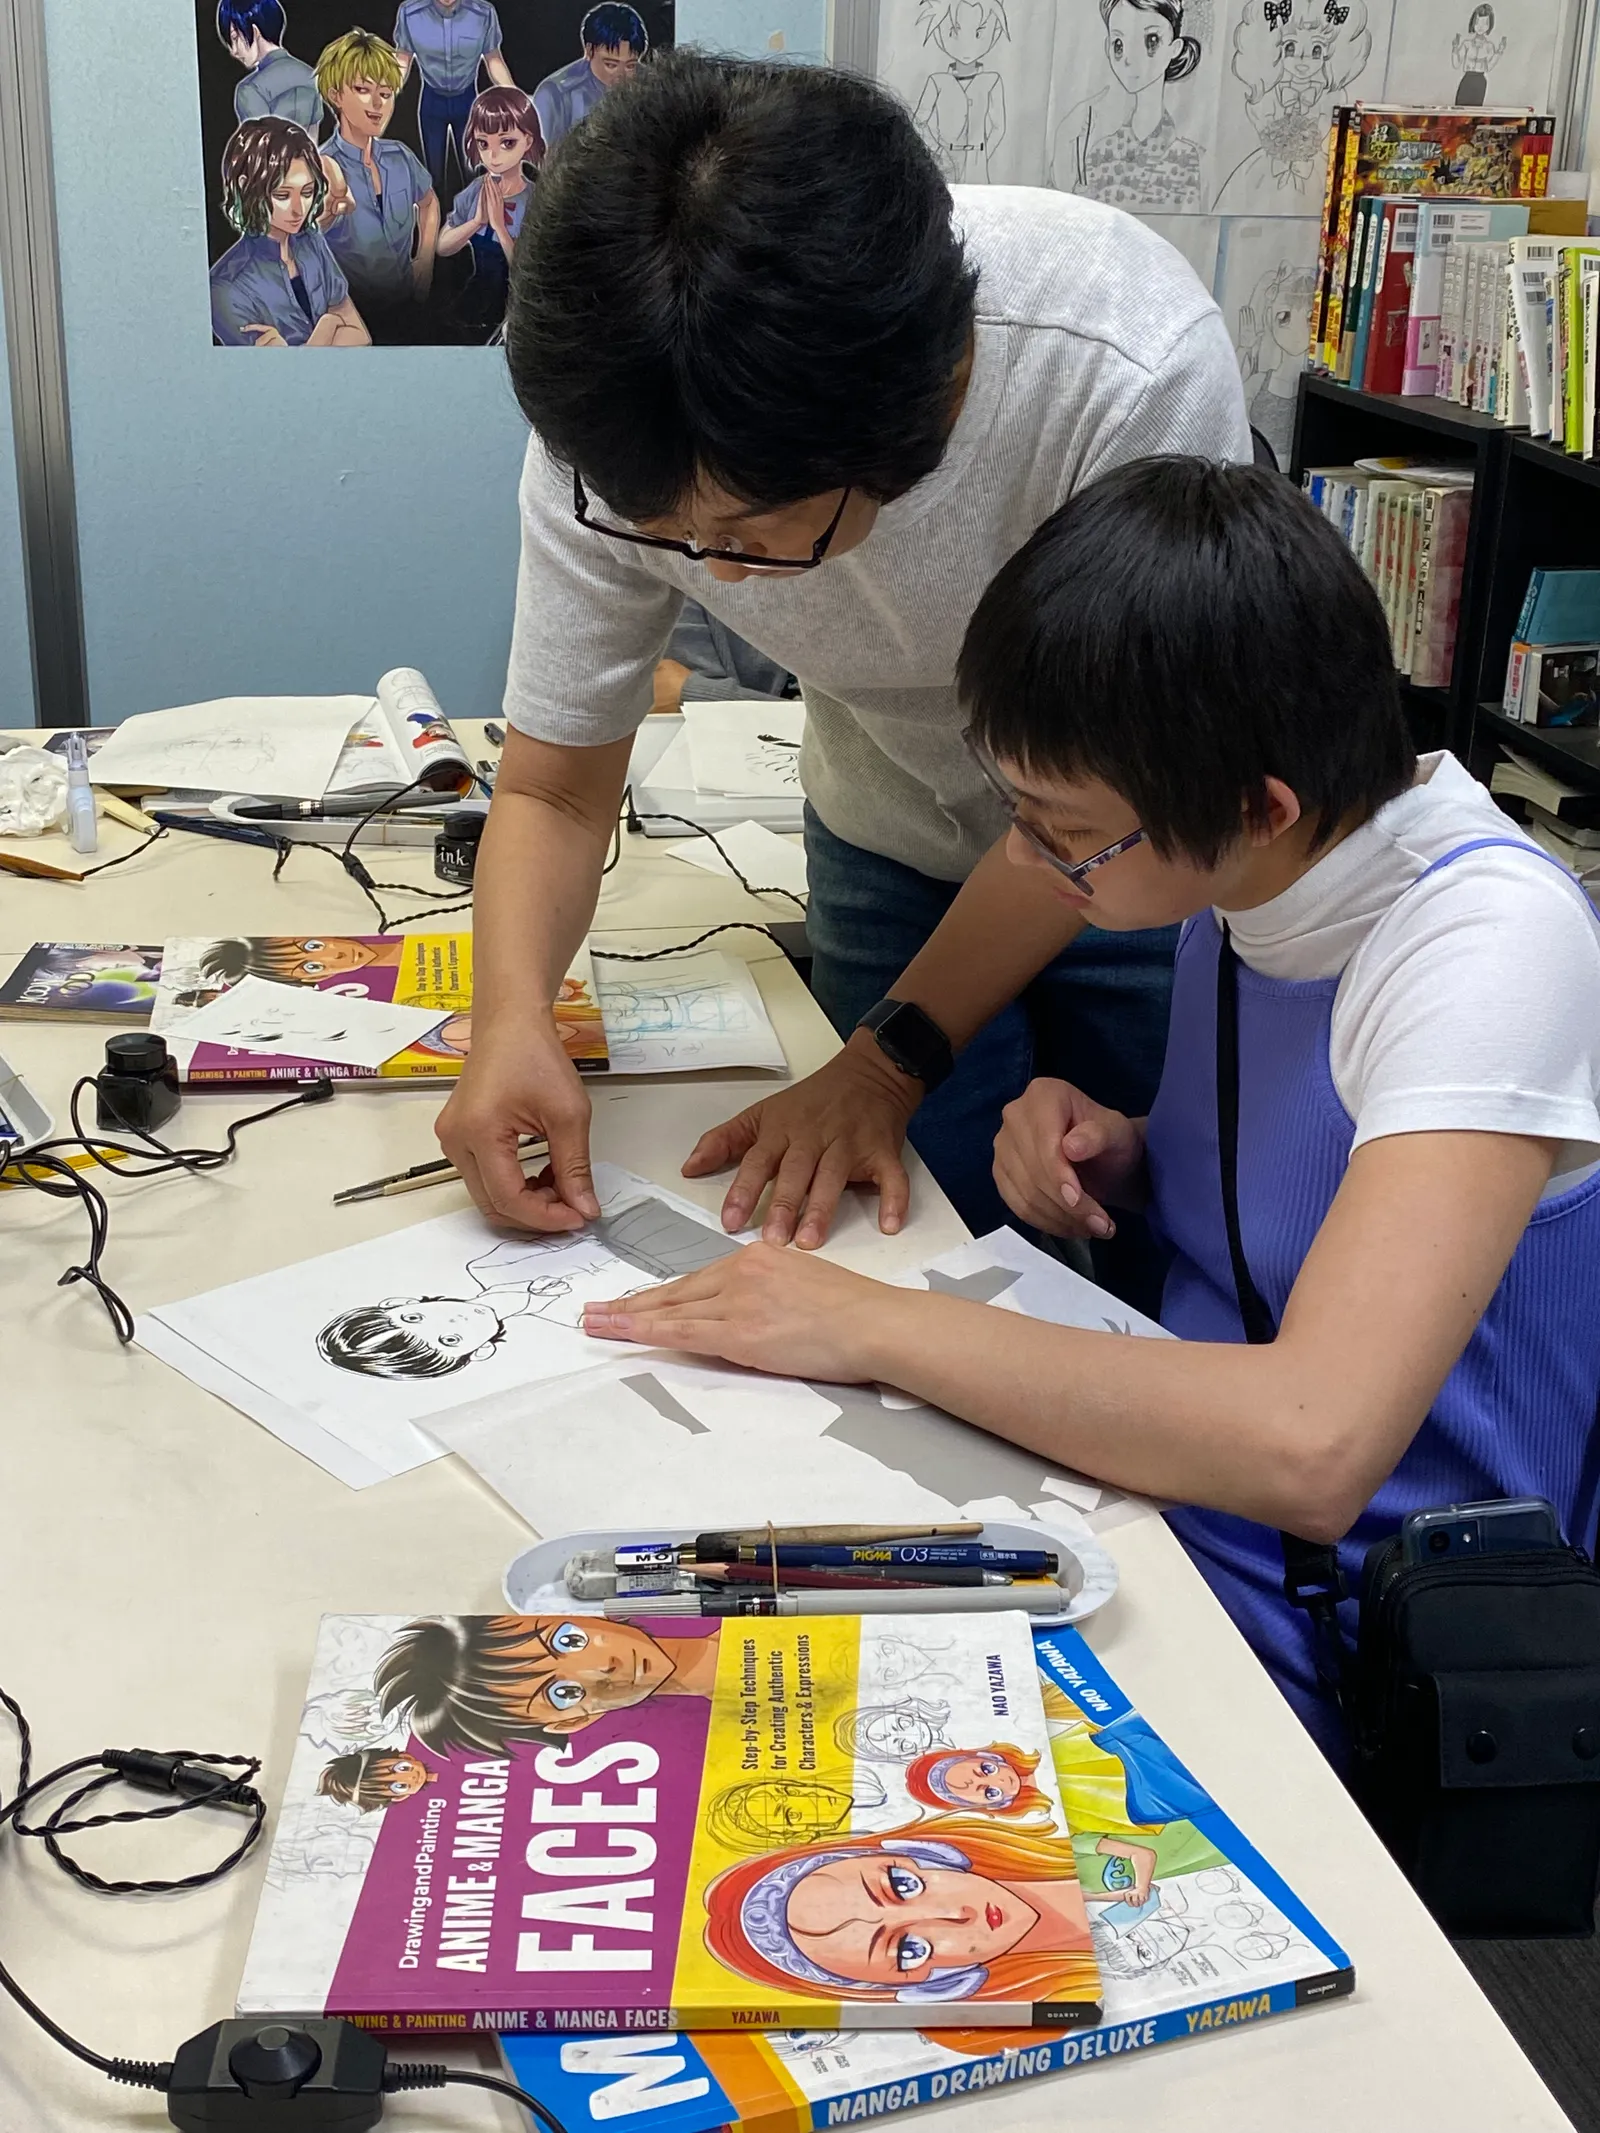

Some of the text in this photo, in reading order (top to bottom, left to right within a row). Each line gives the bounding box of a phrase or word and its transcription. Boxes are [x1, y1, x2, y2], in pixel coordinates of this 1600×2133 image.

[436, 847, 470, 867] ink
[189, 1071, 224, 1080] DRAWING
[233, 1069, 268, 1079] PAINTING
[270, 1067, 301, 1079] ANIME
[304, 1067, 311, 1078] &
[853, 1550, 892, 1561] PIGMA
[900, 1547, 928, 1562] 03
[740, 1638, 759, 1698] Techniques
[986, 1654, 1010, 1716] NAO YAZAWA
[1036, 1640, 1113, 1713] NAO YAZAWA
[767, 1650, 788, 1770] for Creating Authentic
[794, 1634, 816, 1770] Characters & Expressions
[436, 1759, 511, 1973] ANIME & MANGA
[516, 1741, 661, 1972] FACES
[393, 2015, 402, 2028] &
[406, 2014, 467, 2028] PAINTING
[472, 2011, 529, 2029] ANIME
[535, 2011, 547, 2028] &
[555, 2010, 618, 2028] MANGA
[625, 2009, 678, 2027] FACES
[731, 2010, 781, 2025] YAZAWA
[1186, 1993, 1272, 2034] YAZAWA
[827, 2021, 1156, 2127] MANGA DRAWING DELUXE
